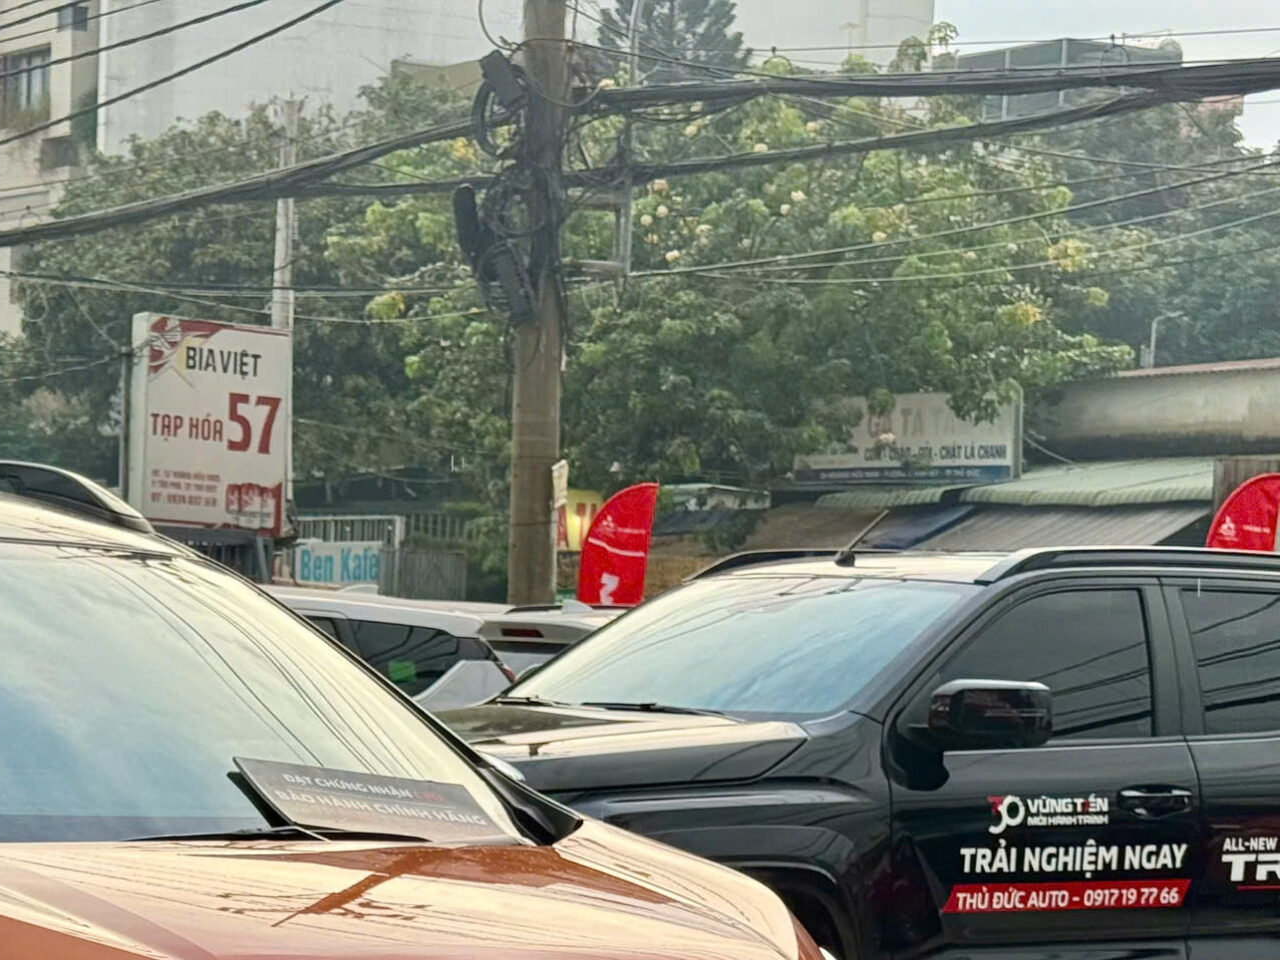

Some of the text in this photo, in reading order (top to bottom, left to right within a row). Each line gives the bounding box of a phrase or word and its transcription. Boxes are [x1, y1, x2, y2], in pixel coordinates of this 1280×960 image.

[185, 346, 262, 380] BIA VIỆT
[151, 412, 224, 442] TẠP HÓA
[227, 392, 282, 455] 57
[300, 547, 380, 582] Ben Kafe
[987, 794, 1026, 835] 30
[959, 838, 1187, 879] TRẢI NGHIỆM NGAY
[1222, 836, 1278, 851] ALL-NEW
[956, 886, 988, 910] THỦ
[992, 887, 1026, 910] ĐỨC
[1028, 892, 1069, 908] AUTO
[1083, 889, 1119, 907] 0917
[1121, 889, 1138, 906] 19
[1140, 888, 1158, 905] 77
[1160, 886, 1179, 904] 66
